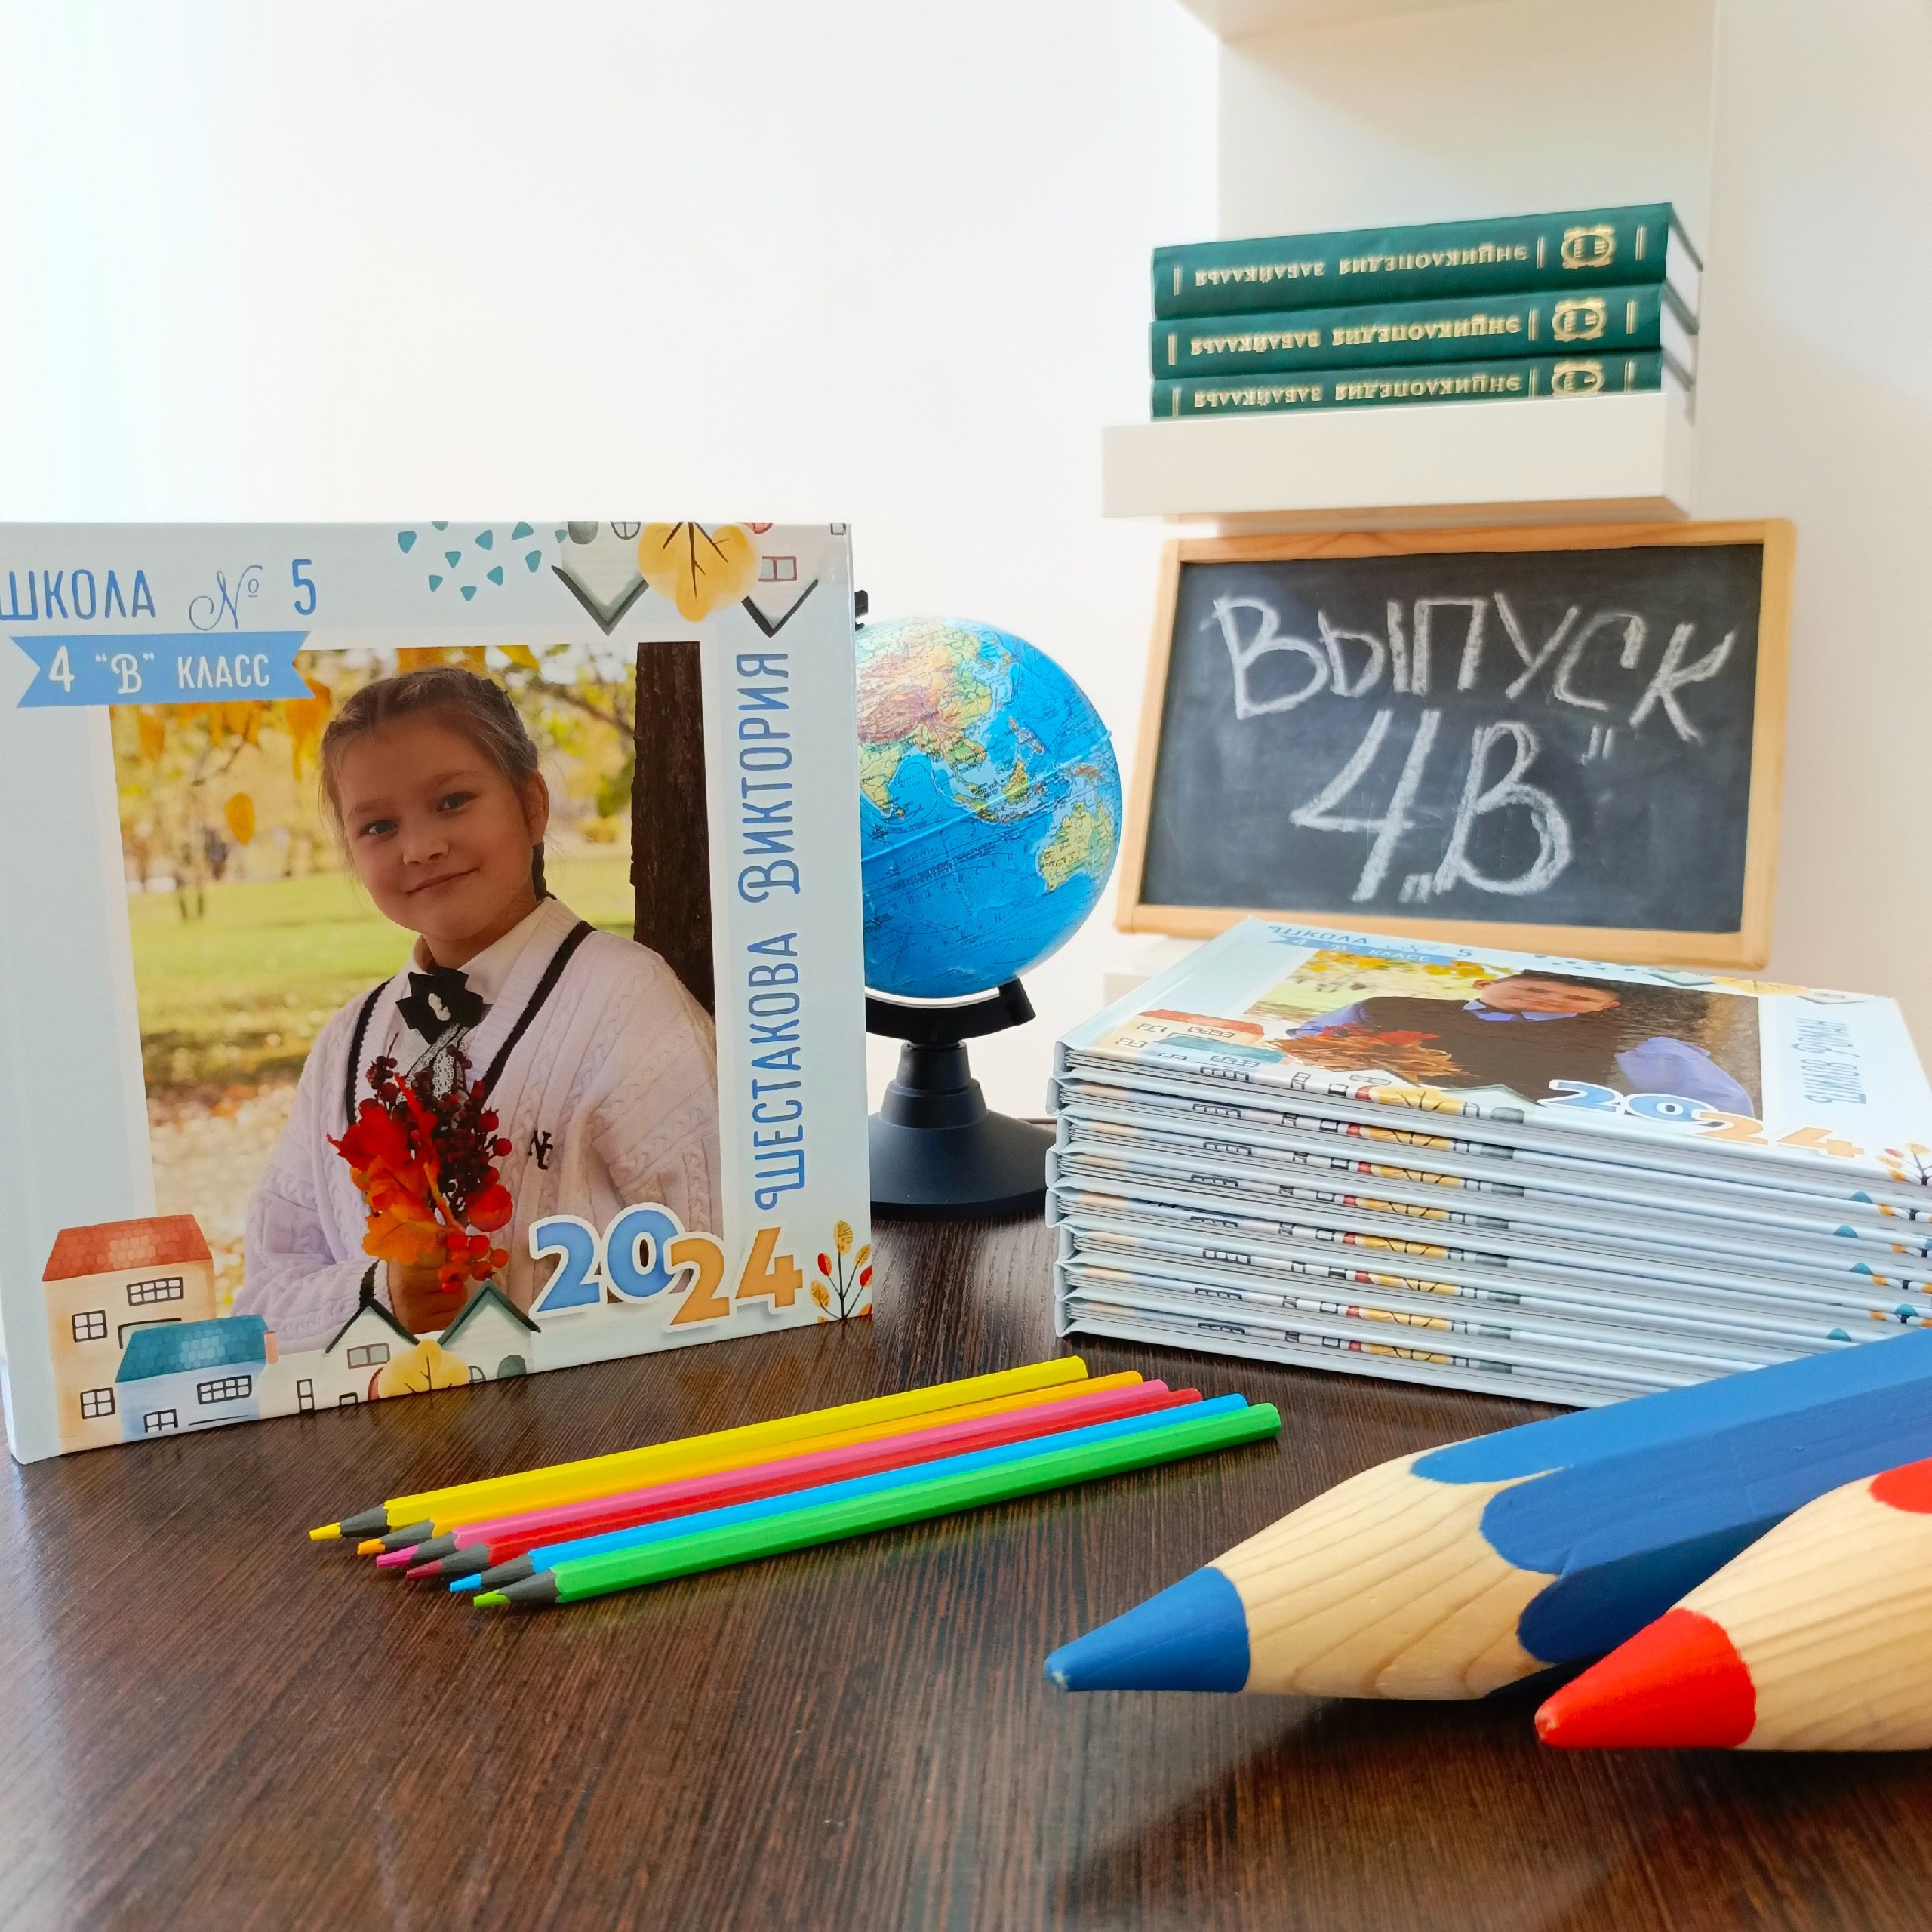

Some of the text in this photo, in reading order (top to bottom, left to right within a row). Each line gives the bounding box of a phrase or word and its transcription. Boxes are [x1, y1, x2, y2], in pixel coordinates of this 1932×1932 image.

[1195, 244, 1530, 287] ЭНЦИКЛОПЕДИЯ ЗАБАЙКАЛЬЯ
[1190, 315, 1522, 355] ЭНЦИКЛОПЕДИЯ ЗАБАЙКАЛЬЯ
[1193, 377, 1523, 408] ЭНЦИКЛОПЕДИЯ ЗАБАЙКАЛЬЯ
[0, 569, 156, 620] ШКОЛА
[291, 558, 317, 616] 5
[48, 645, 75, 693] 4
[177, 654, 270, 690] КЛАСС
[1211, 591, 1734, 746] ВЫПУСК
[736, 652, 805, 1211] ШЕСТАКОВА ВИКТОРИЯ
[1268, 925, 1367, 944] ШКОЛА
[1456, 949, 1473, 957] 5
[1367, 949, 1431, 962] КЛАСС
[1542, 1081, 1865, 1160] 2024
[533, 1207, 804, 1327] 2024
